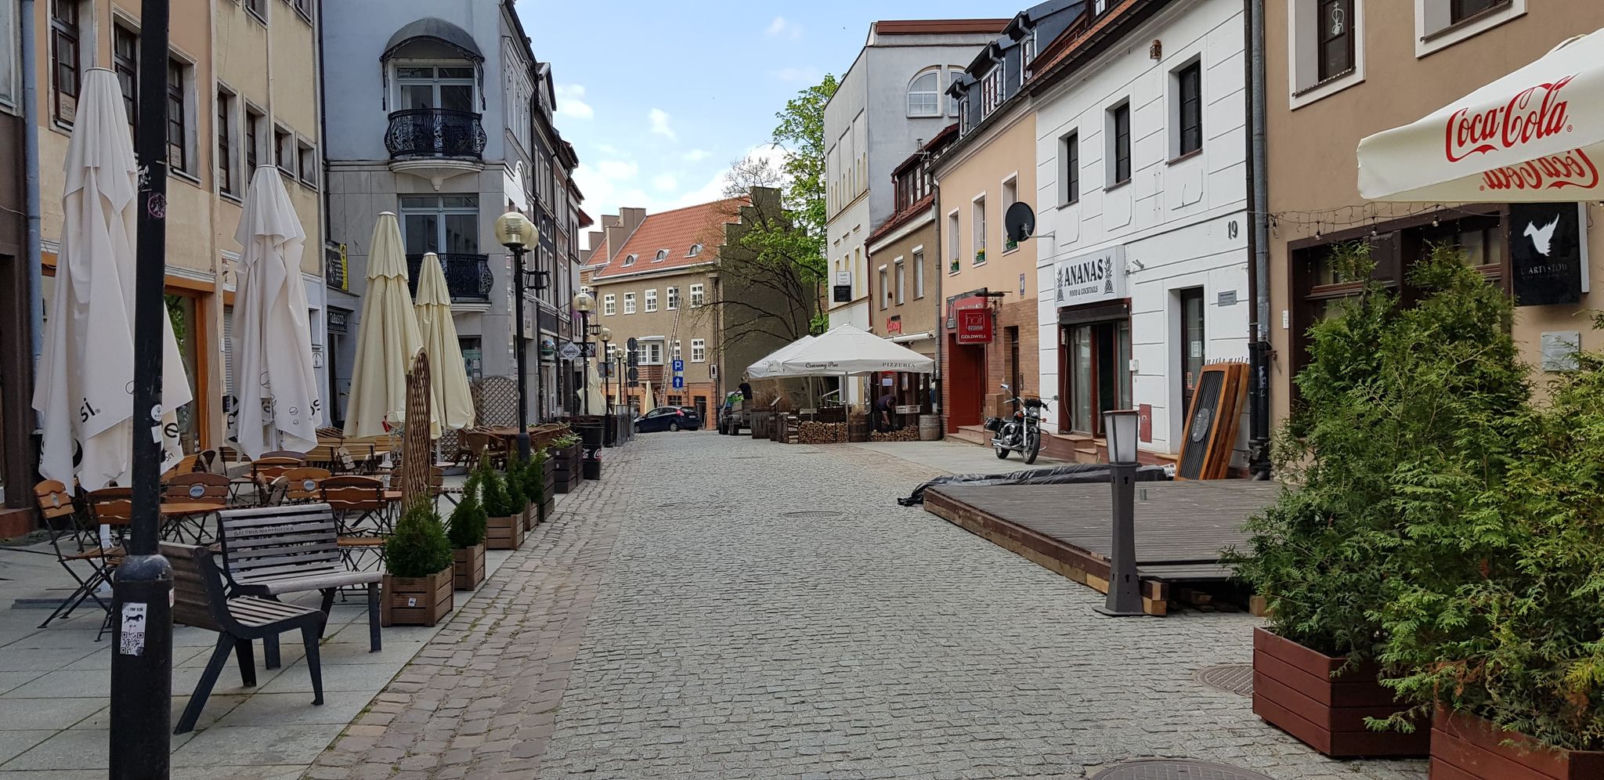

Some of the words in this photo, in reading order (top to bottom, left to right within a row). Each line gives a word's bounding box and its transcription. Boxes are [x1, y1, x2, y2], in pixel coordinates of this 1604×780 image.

[1445, 72, 1581, 162] Coca-Cola
[1227, 220, 1238, 240] 19
[1064, 259, 1104, 287] ANANAS
[675, 361, 682, 369] P
